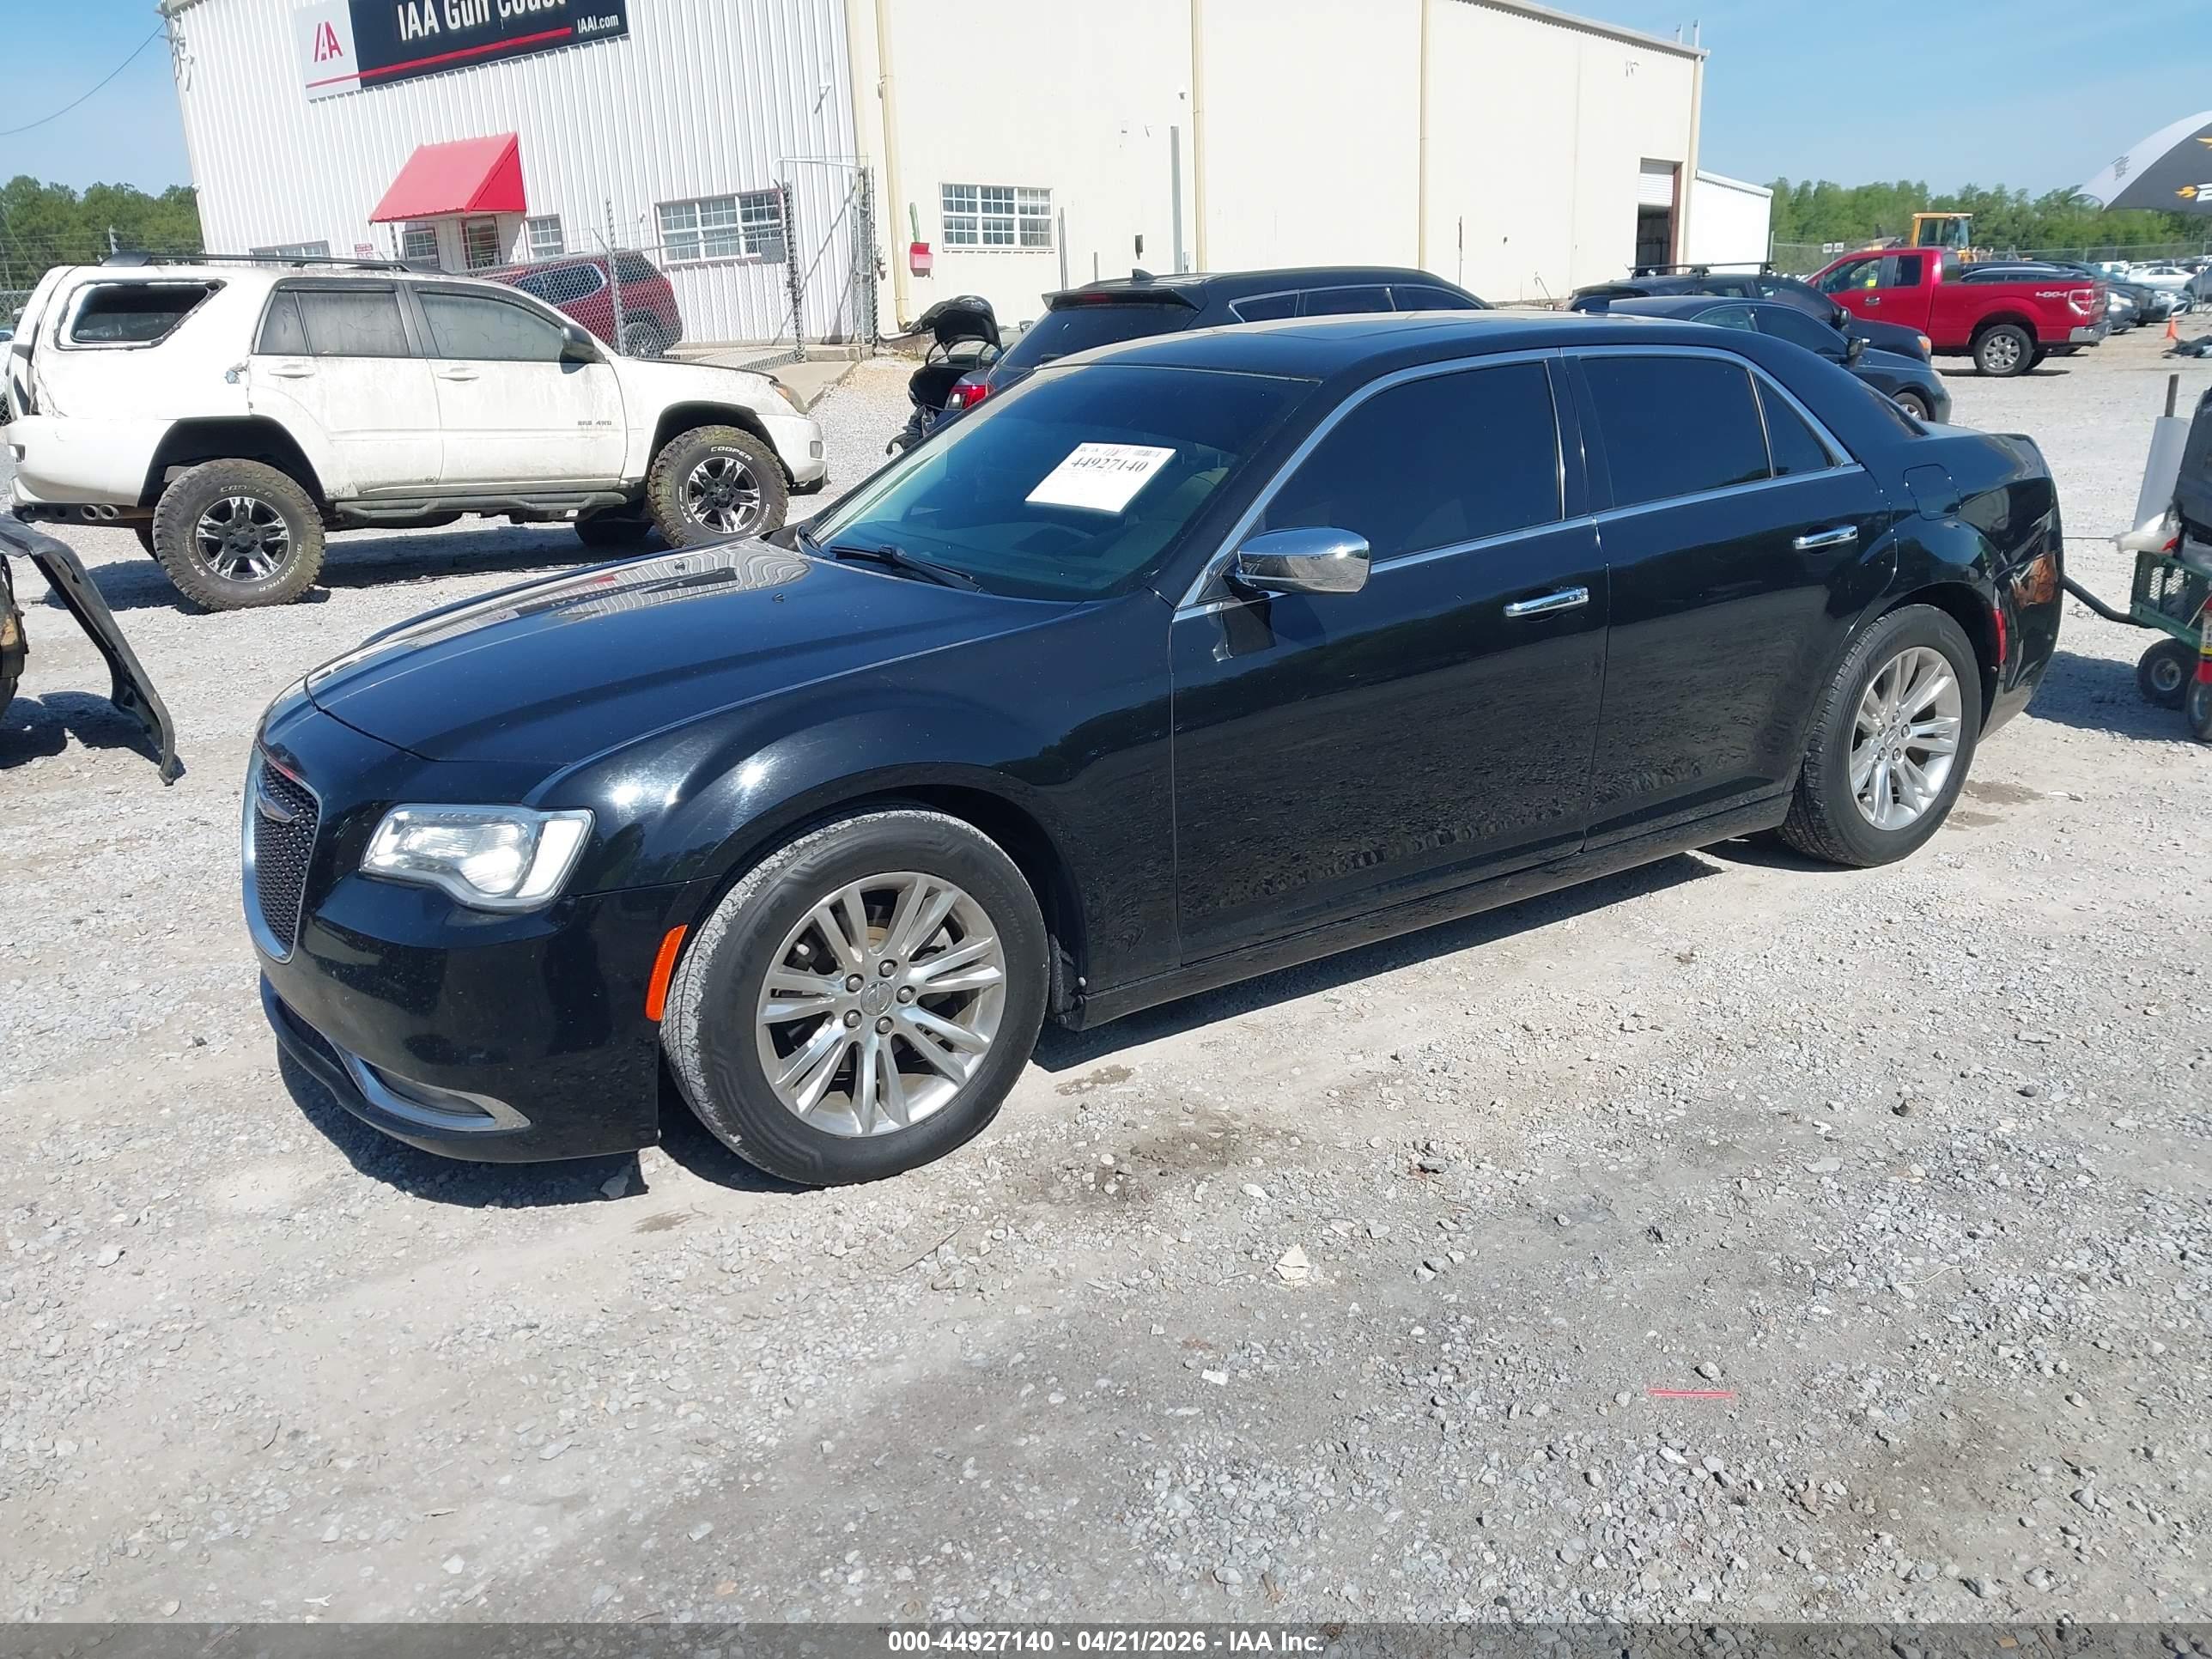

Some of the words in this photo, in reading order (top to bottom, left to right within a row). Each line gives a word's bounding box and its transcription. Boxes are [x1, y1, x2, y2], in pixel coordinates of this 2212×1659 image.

[398, 0, 440, 41] IAA
[577, 14, 619, 33] IAAI.com
[710, 446, 754, 461] COOPER
[1071, 457, 1149, 472] 44927140
